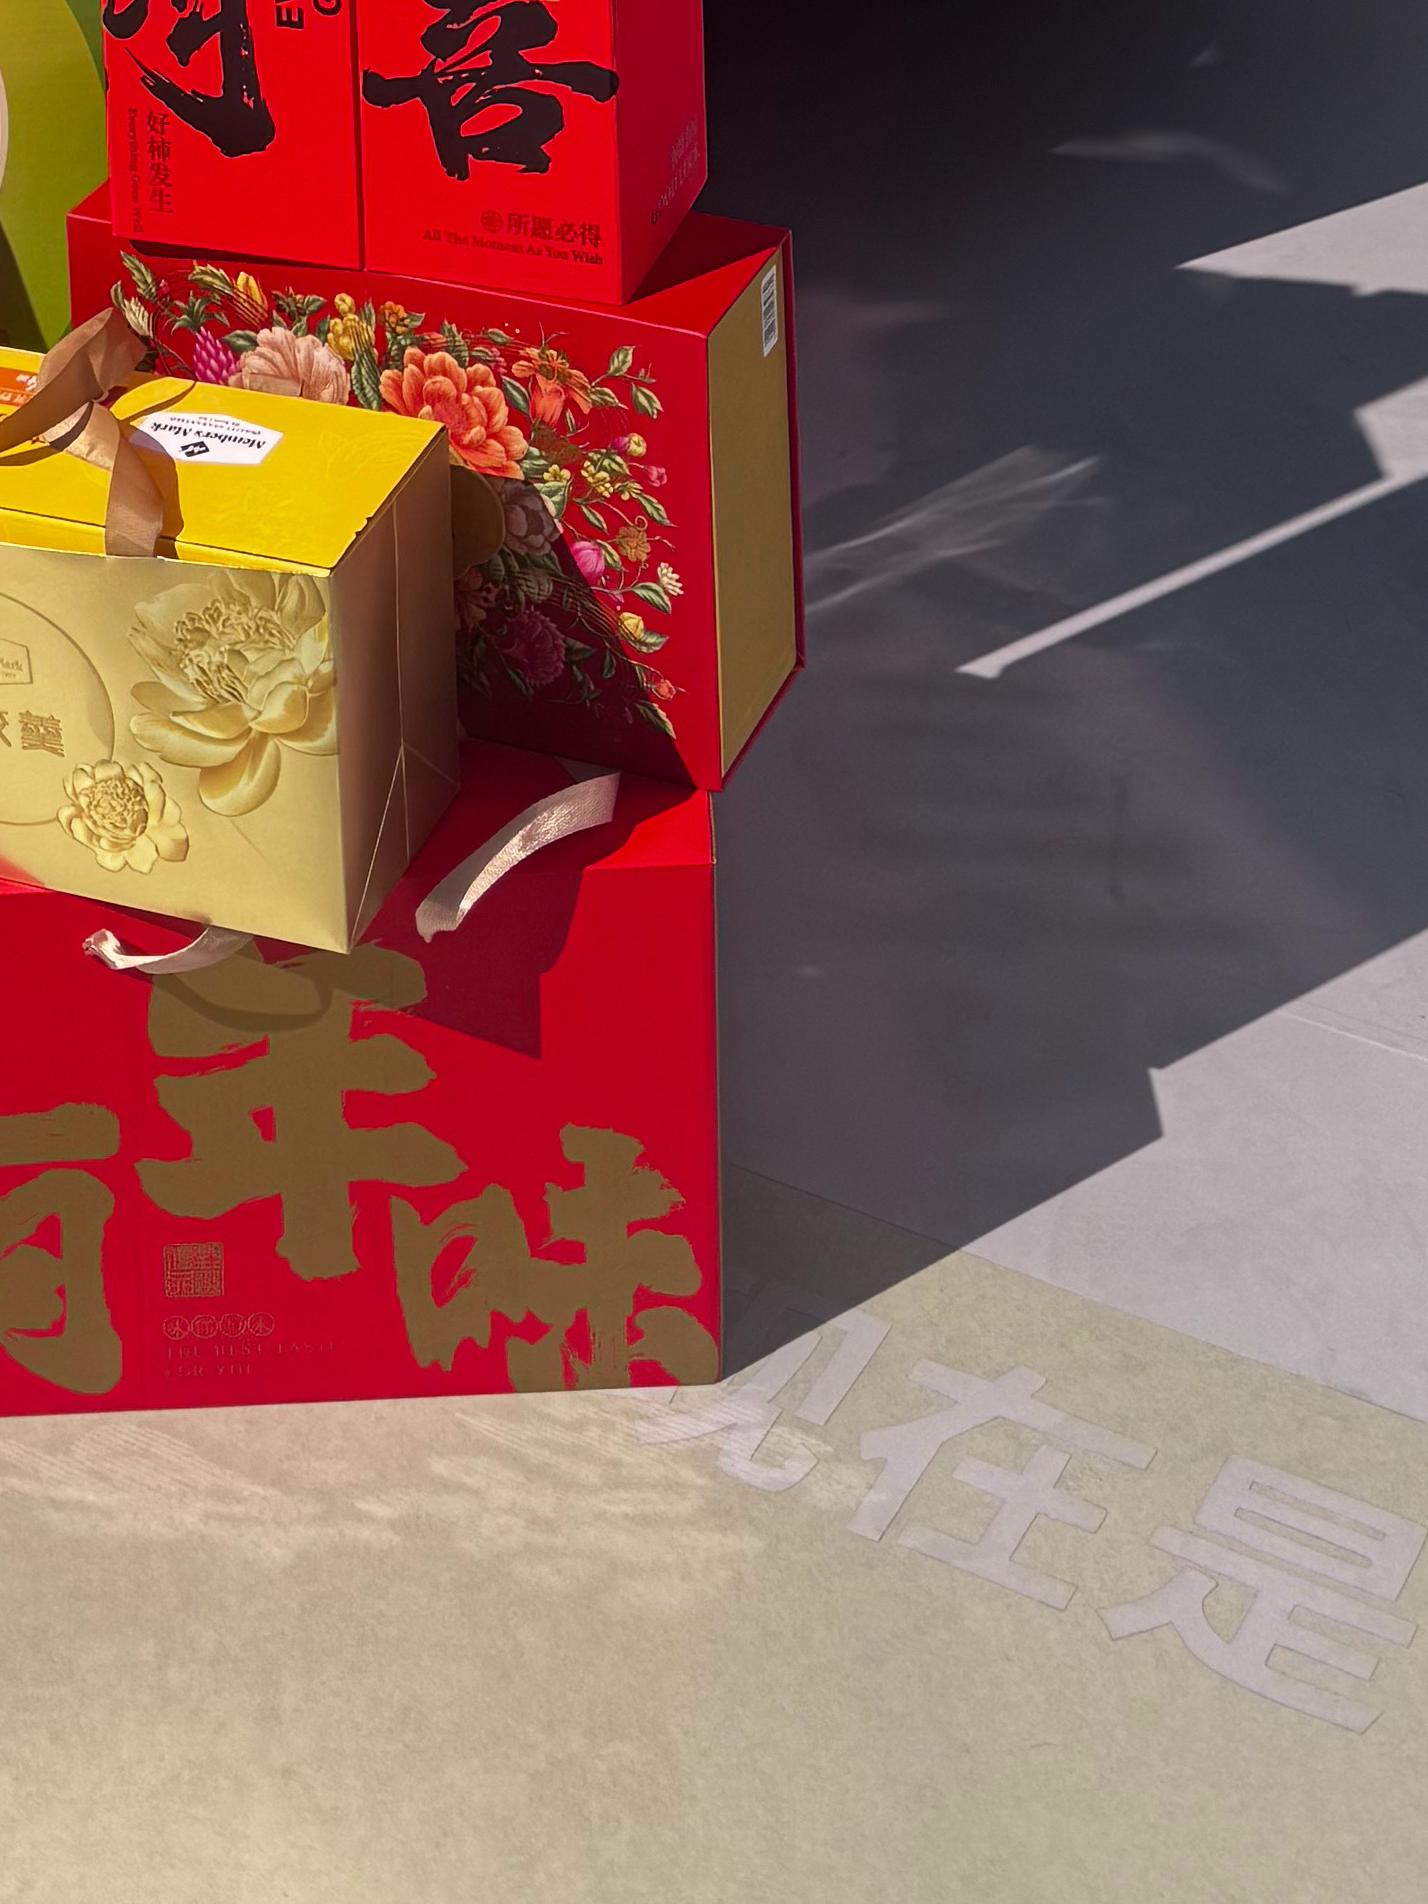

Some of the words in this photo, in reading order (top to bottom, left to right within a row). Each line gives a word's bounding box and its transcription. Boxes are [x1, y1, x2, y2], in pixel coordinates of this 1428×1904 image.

[146, 110, 175, 214] 好柿发生
[424, 228, 441, 242] All
[444, 230, 470, 246] The
[473, 235, 524, 254] Moment
[526, 243, 543, 257] As
[544, 245, 569, 261] You
[572, 249, 604, 265] Wish
[506, 212, 603, 249] 所愿必得
[150, 421, 193, 438] Mark
[194, 429, 266, 450] Member's
